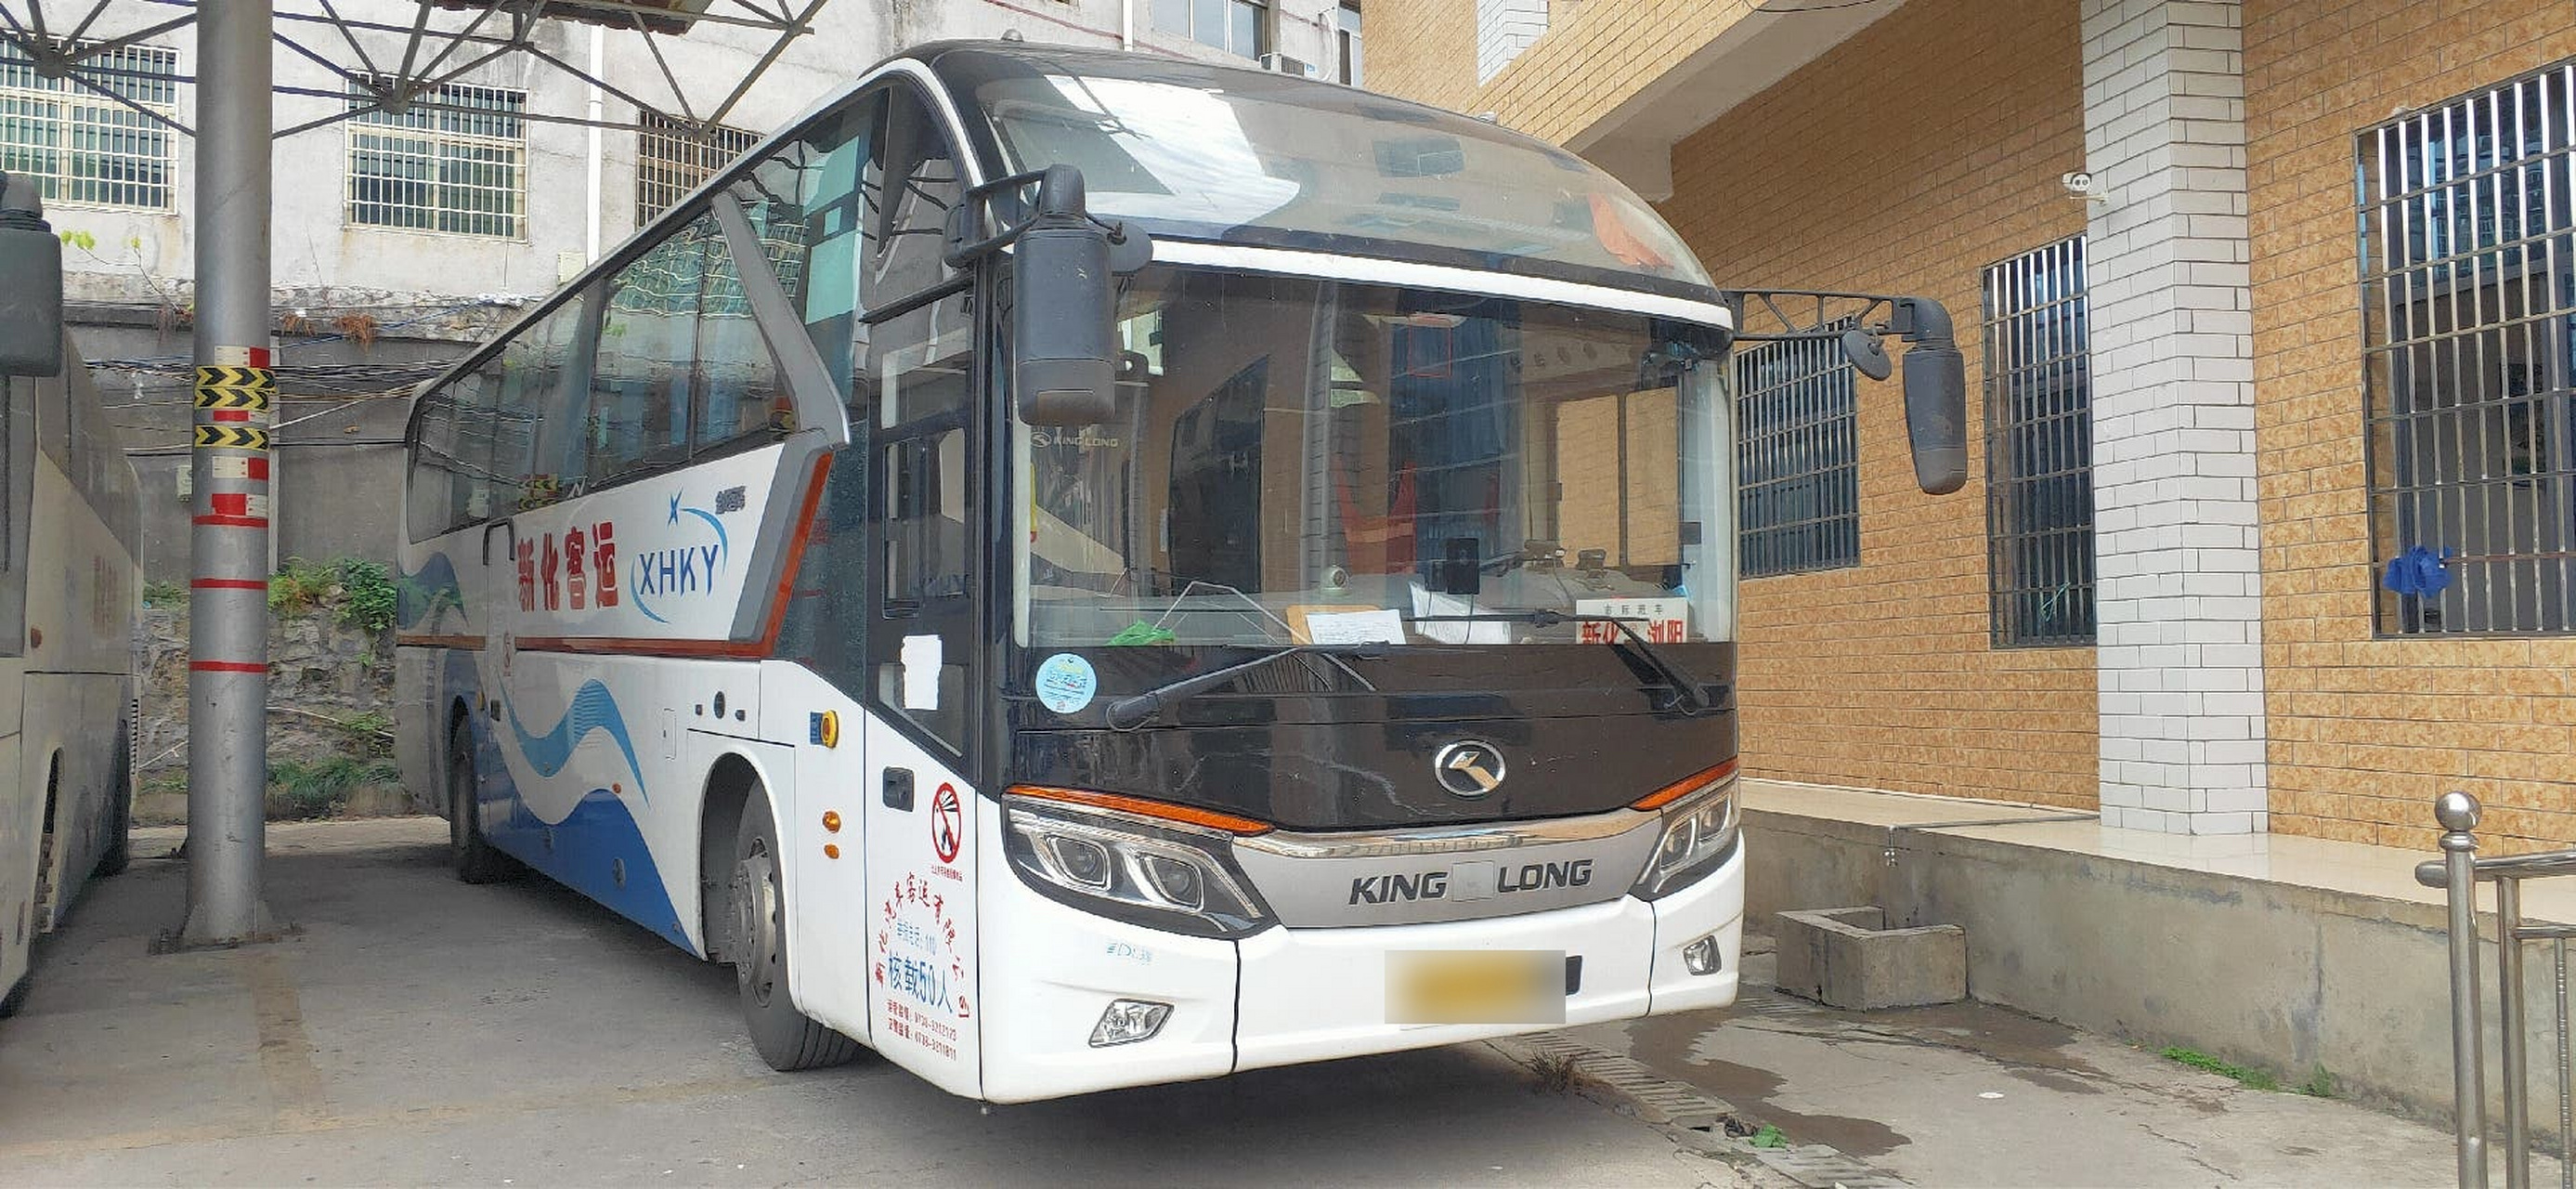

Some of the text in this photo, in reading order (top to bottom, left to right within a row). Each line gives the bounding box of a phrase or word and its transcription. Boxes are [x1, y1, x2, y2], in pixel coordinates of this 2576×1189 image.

[517, 521, 619, 612] 新化客运
[639, 544, 720, 599] XHKY
[1581, 620, 1619, 645] 新化
[1348, 857, 1594, 906] KING LONG
[888, 948, 954, 1014] 核载50人
